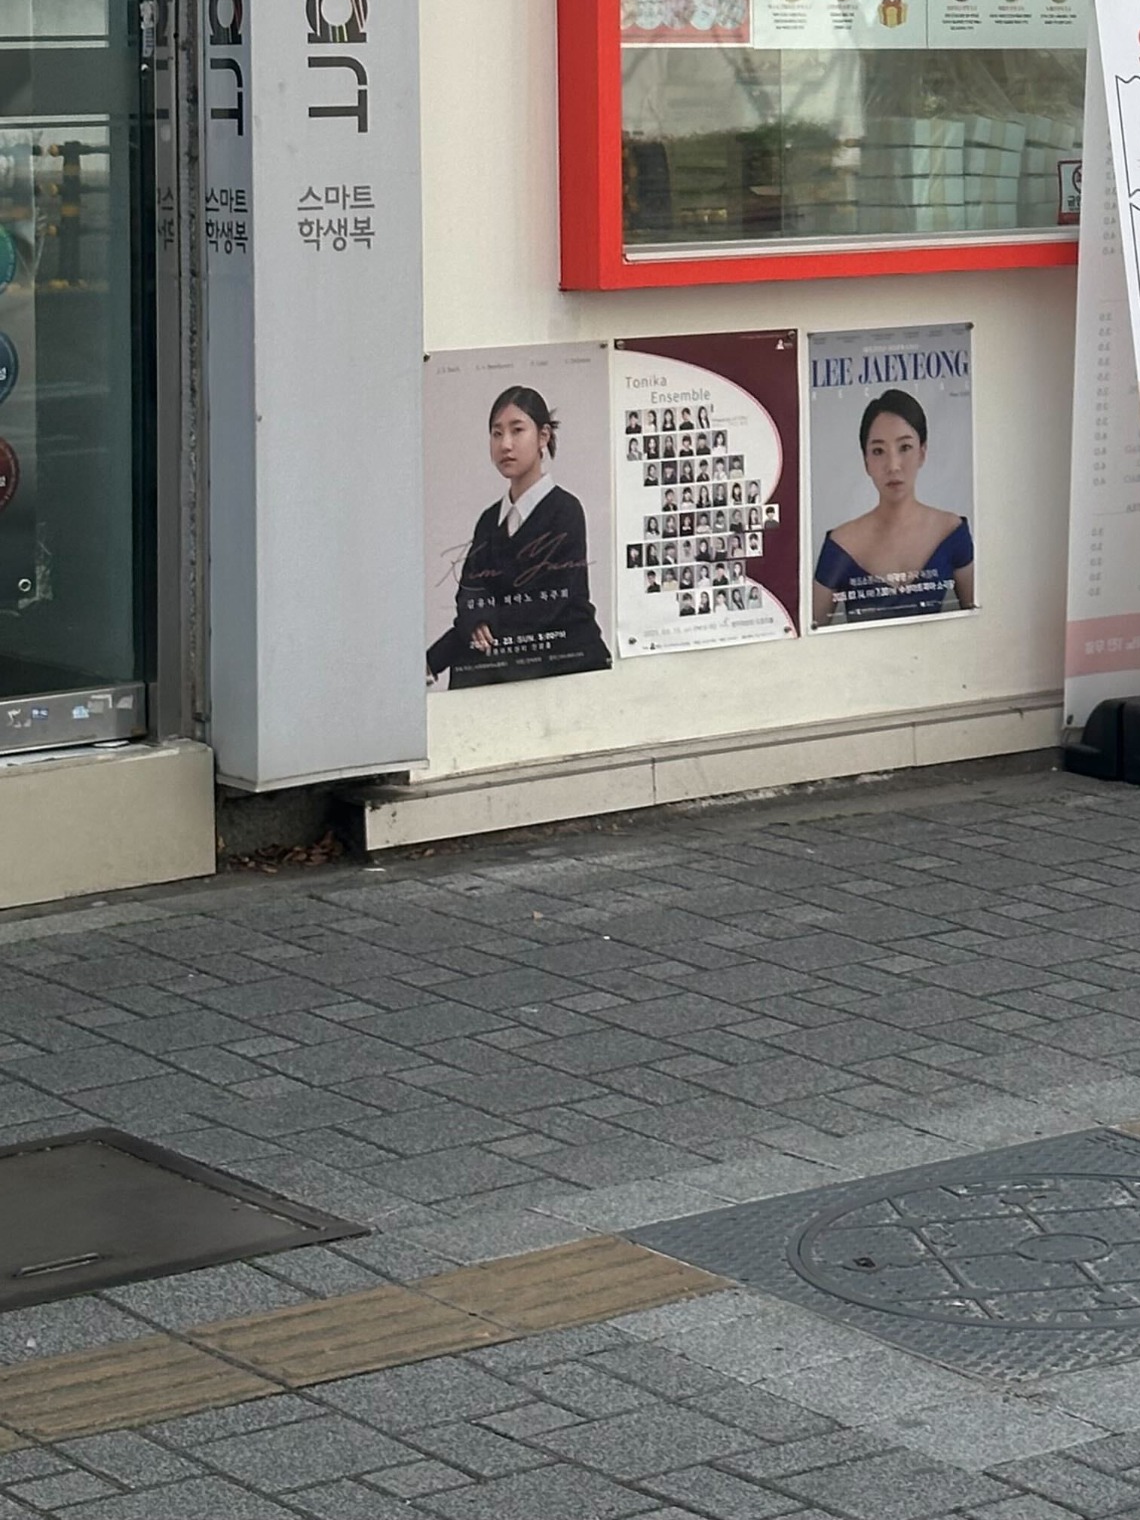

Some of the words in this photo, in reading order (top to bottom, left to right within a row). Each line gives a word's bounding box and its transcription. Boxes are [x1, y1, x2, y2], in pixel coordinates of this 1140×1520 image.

[205, 186, 249, 215] 스마트
[297, 185, 376, 212] 스마트
[205, 219, 249, 254] 학생복
[297, 217, 376, 252] 학생복
[625, 375, 667, 389] Tonika
[812, 357, 853, 388] LEE
[858, 349, 969, 385] JAEYEONG
[651, 388, 711, 405] Ensemble
